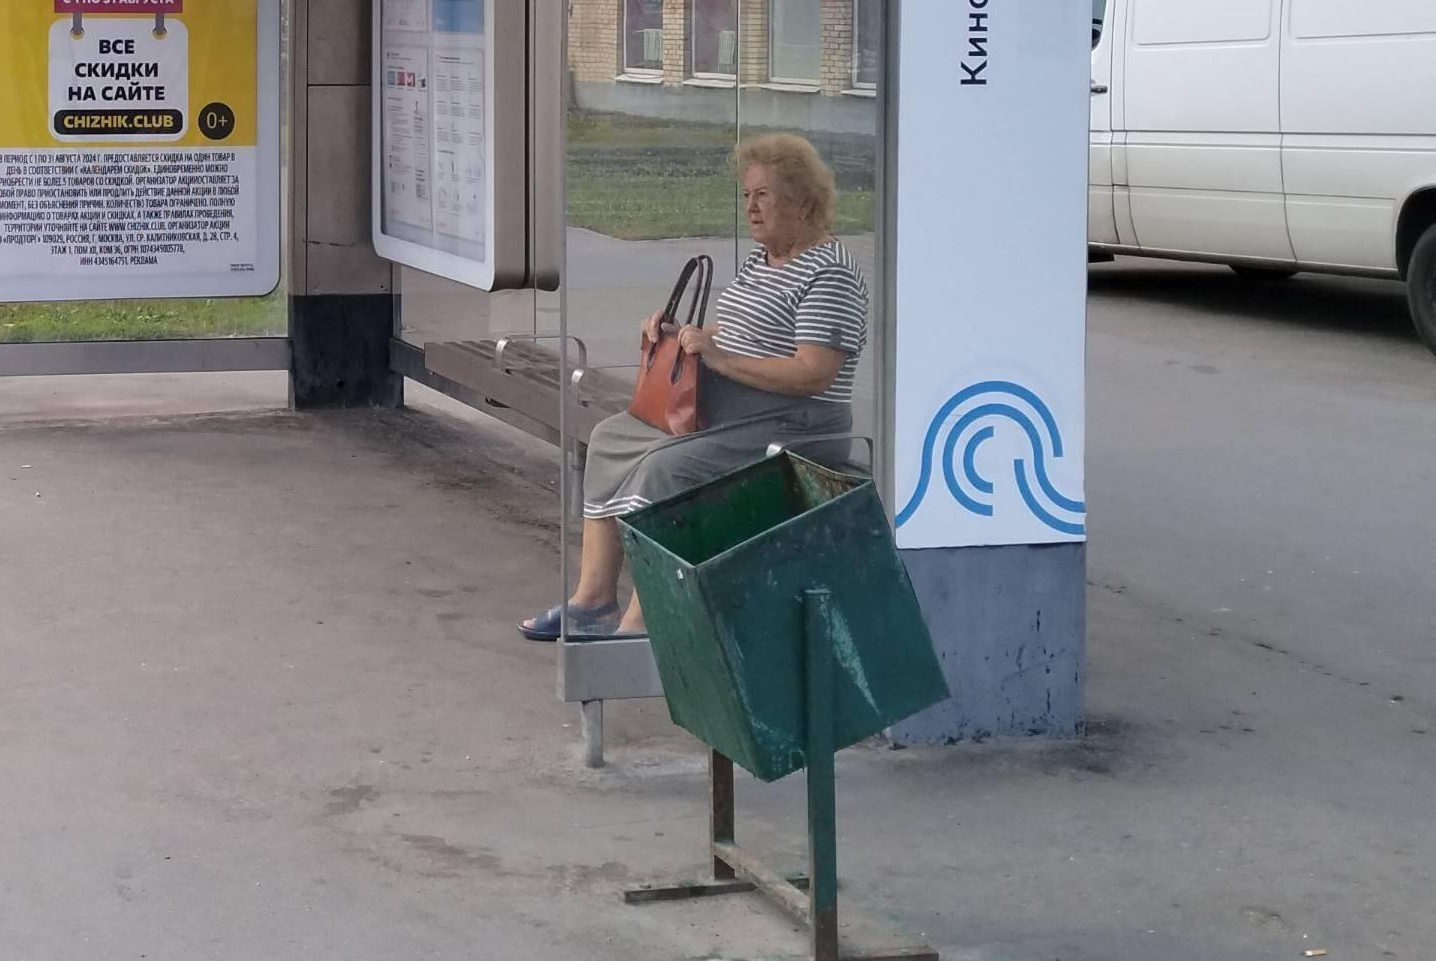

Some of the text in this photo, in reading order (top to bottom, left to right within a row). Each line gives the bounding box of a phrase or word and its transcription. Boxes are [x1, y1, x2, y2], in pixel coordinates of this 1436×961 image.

[99, 39, 135, 54] ВСЕ
[74, 62, 159, 80] СКИДКИ
[68, 82, 165, 101] НА САЙТЕ
[64, 115, 174, 129] CHIZHIK.CLUB
[206, 111, 228, 129] 0+
[4, 154, 28, 165] ПЕРИОД
[55, 154, 81, 163] АВГУСТА
[83, 154, 96, 163] 2024
[104, 153, 159, 164] ПРЕДОСТАВЛЯЕТСЯ
[160, 153, 183, 163] СКИДКА
[184, 153, 193, 162] НА
[194, 153, 210, 163] ОДИН
[212, 153, 230, 162] ТОВАР
[205, 164, 228, 173] МОЖНО
[68, 177, 95, 185] ТОВАРОВ
[95, 177, 104, 185] СО
[136, 176, 177, 185] ОРГАНИЗАТОР
[16, 189, 36, 198] ПРАВО
[37, 188, 88, 197] ПРИОСТАНОВИТЬ
[89, 188, 102, 197] ИЛИ
[103, 188, 134, 198] ПРОДЛИТЬ
[135, 186, 165, 198] ДЕЙСТВИЕ
[166, 186, 190, 197] ДАННОЙ
[28, 200, 38, 209] БЕЗ
[39, 200, 78, 209] ОБЪЯСНЕНИЯ
[146, 199, 168, 208] ТОВАРА
[210, 198, 235, 207] ПОЛНУЮ
[0, 211, 45, 221] ИНФОРМАЦИЮ
[52, 211, 79, 220] ТОВАРАХ
[143, 210, 163, 219] ТАКЖЕ
[164, 210, 194, 218] ПРАВИЛАХ
[4, 223, 42, 232] ТЕРРИТОРИИ
[44, 221, 78, 231] УТОЧНЯЙТЕ
[80, 222, 87, 231] НА
[89, 221, 107, 231] САЙТЕ
[168, 221, 208, 230] ОРГАНИЗАТОР
[210, 221, 230, 231] АКЦИИ
[50, 246, 67, 254] ЭТАЖ
[130, 256, 158, 265] РЕКЛАМА
